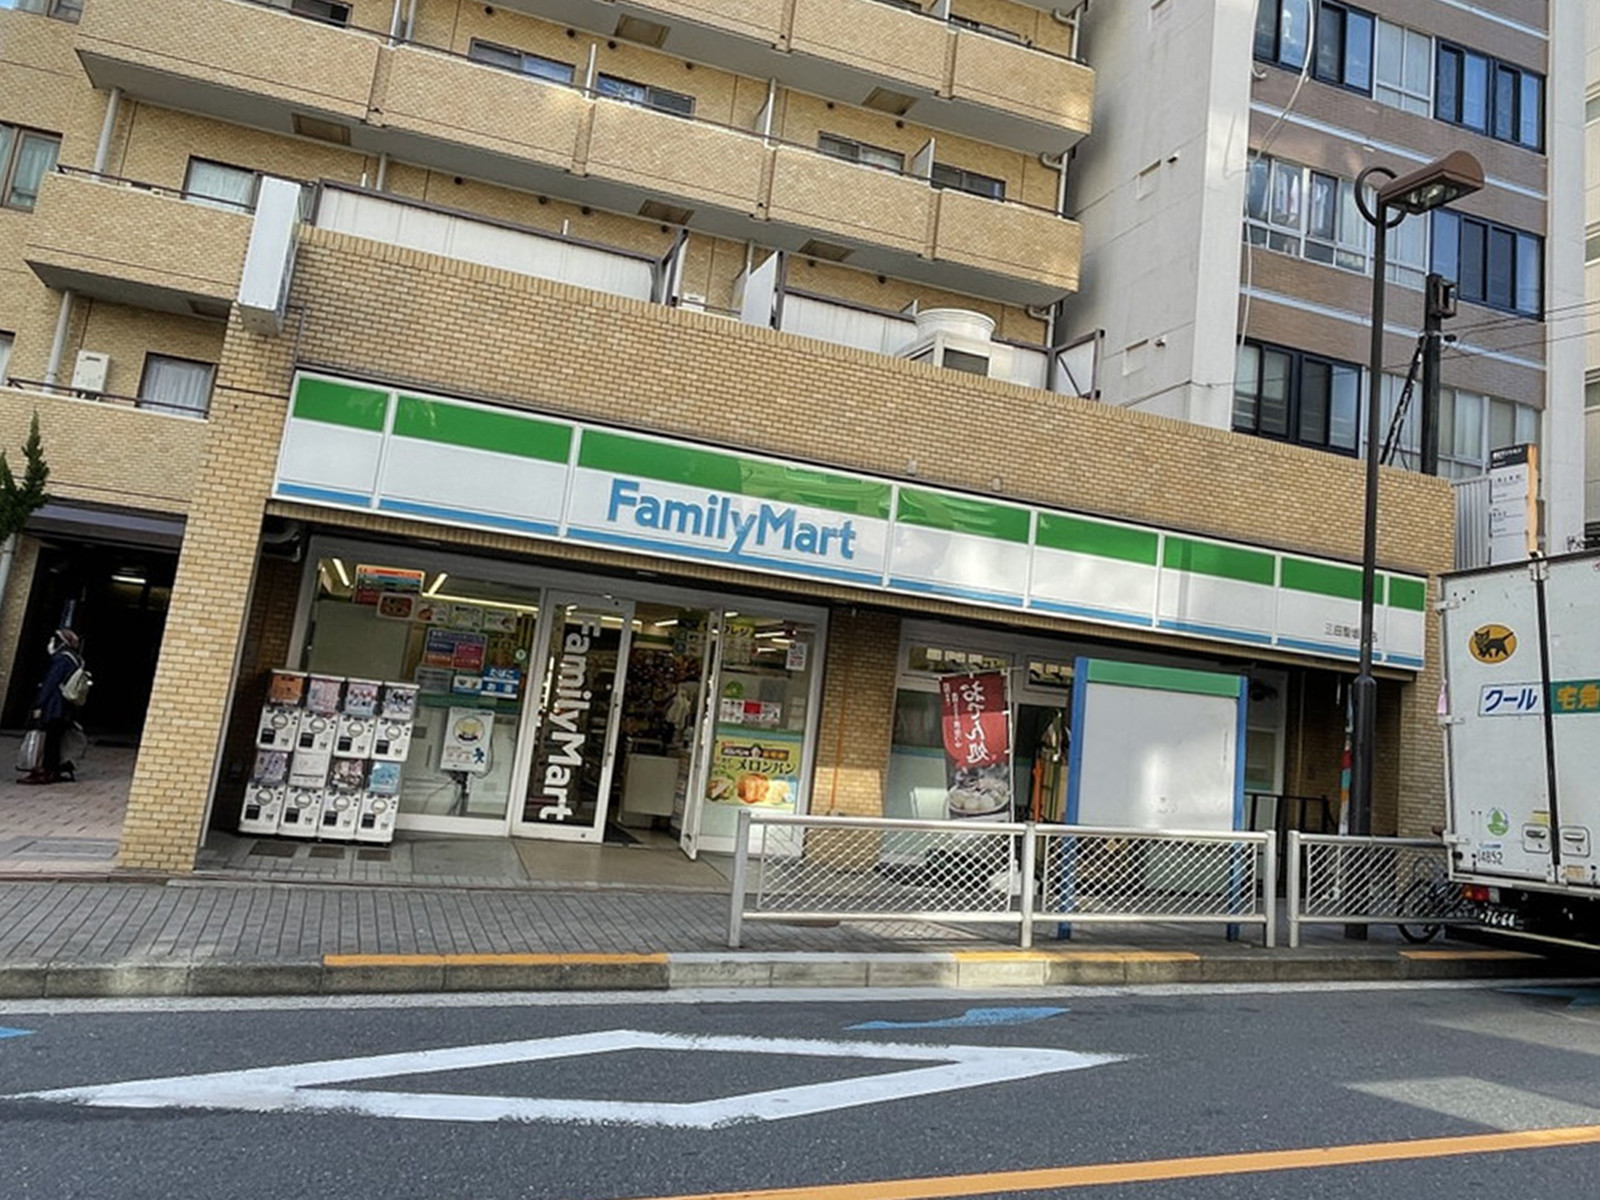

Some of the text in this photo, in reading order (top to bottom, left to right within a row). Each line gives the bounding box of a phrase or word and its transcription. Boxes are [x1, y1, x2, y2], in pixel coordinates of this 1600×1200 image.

[607, 478, 857, 560] FamilyMart
[539, 616, 601, 820] FamilyMart
[1485, 688, 1538, 713] クール
[736, 758, 796, 775] メロンパン
